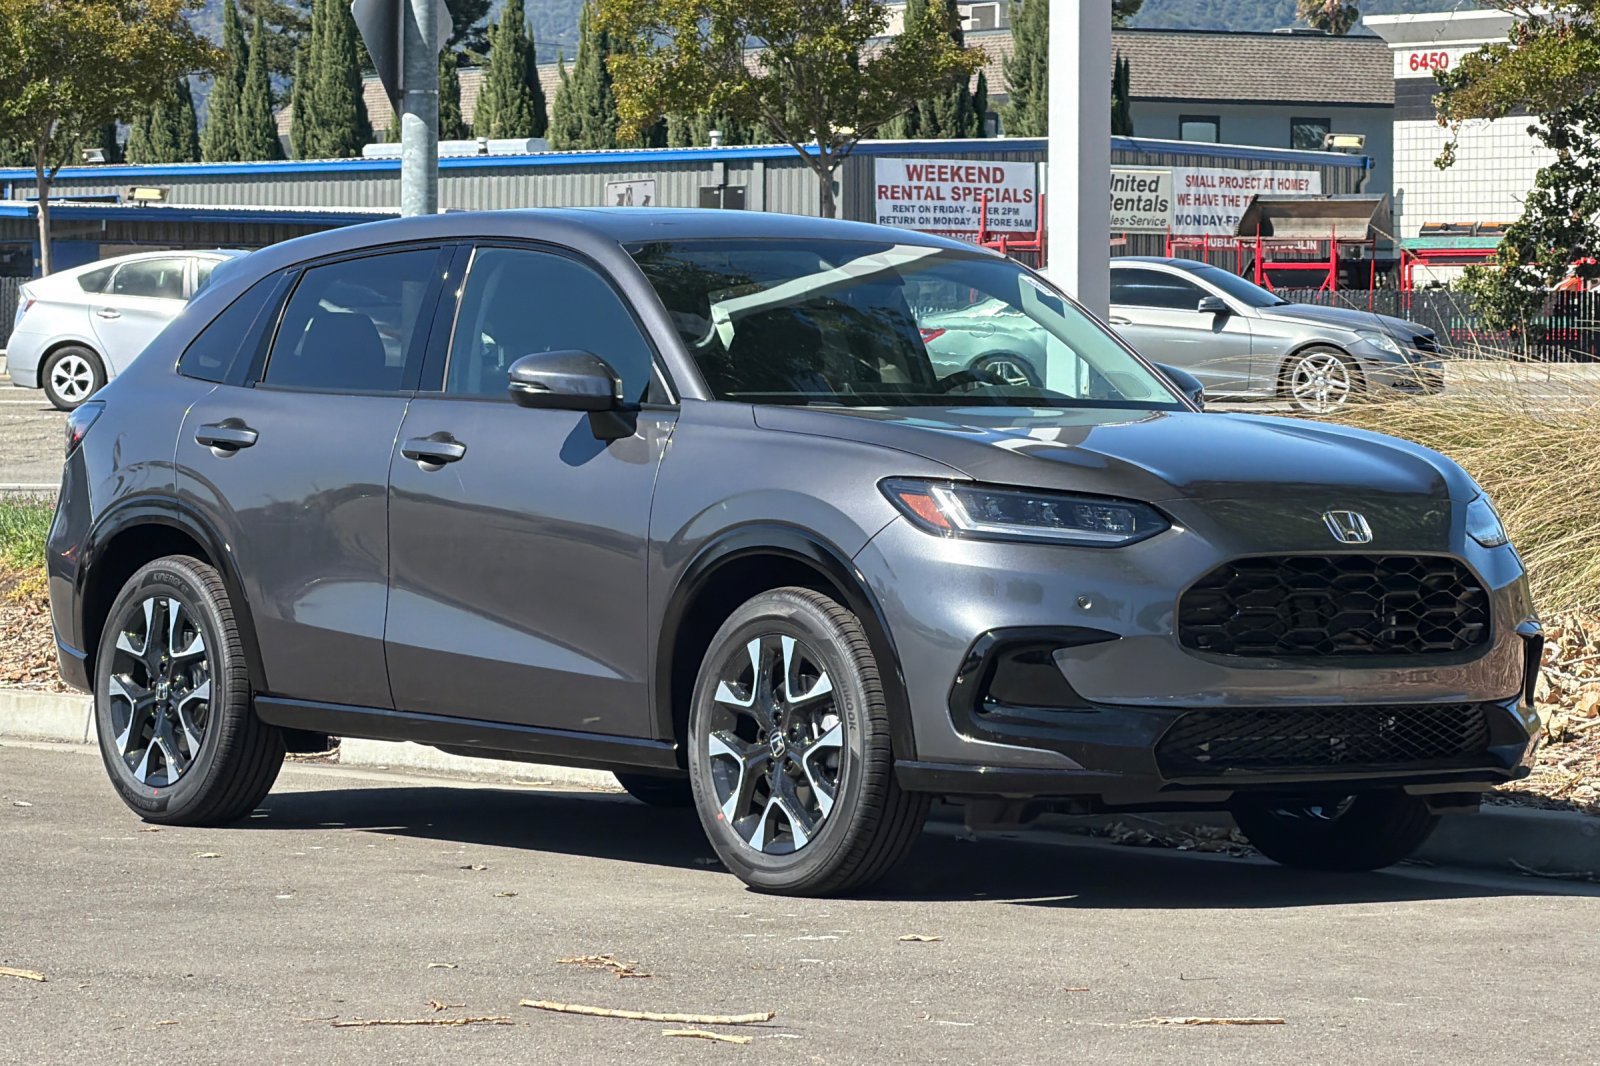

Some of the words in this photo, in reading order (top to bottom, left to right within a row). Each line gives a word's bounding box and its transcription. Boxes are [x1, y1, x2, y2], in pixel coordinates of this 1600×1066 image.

[1409, 52, 1449, 72] 6450
[905, 164, 1005, 184] WEEKEND
[1185, 174, 1217, 189] SMALL
[1219, 176, 1262, 190] PROJECT
[1263, 177, 1275, 190] AT
[1277, 178, 1310, 191] HOME?
[877, 184, 946, 201] RENTAL
[950, 186, 1033, 204] SPECIALS
[1177, 193, 1192, 206] WE
[1193, 193, 1220, 207] HAVE
[1221, 194, 1241, 208] THE
[892, 204, 916, 213] RENT
[918, 205, 931, 214] ON
[933, 205, 965, 215] FRIDAY
[971, 206, 1000, 215] AFER
[1001, 207, 1020, 216] 2PM
[879, 215, 916, 225] RETURN
[918, 216, 931, 225] ON
[933, 216, 971, 226] MONDAY
[1013, 218, 1032, 227] 9AM
